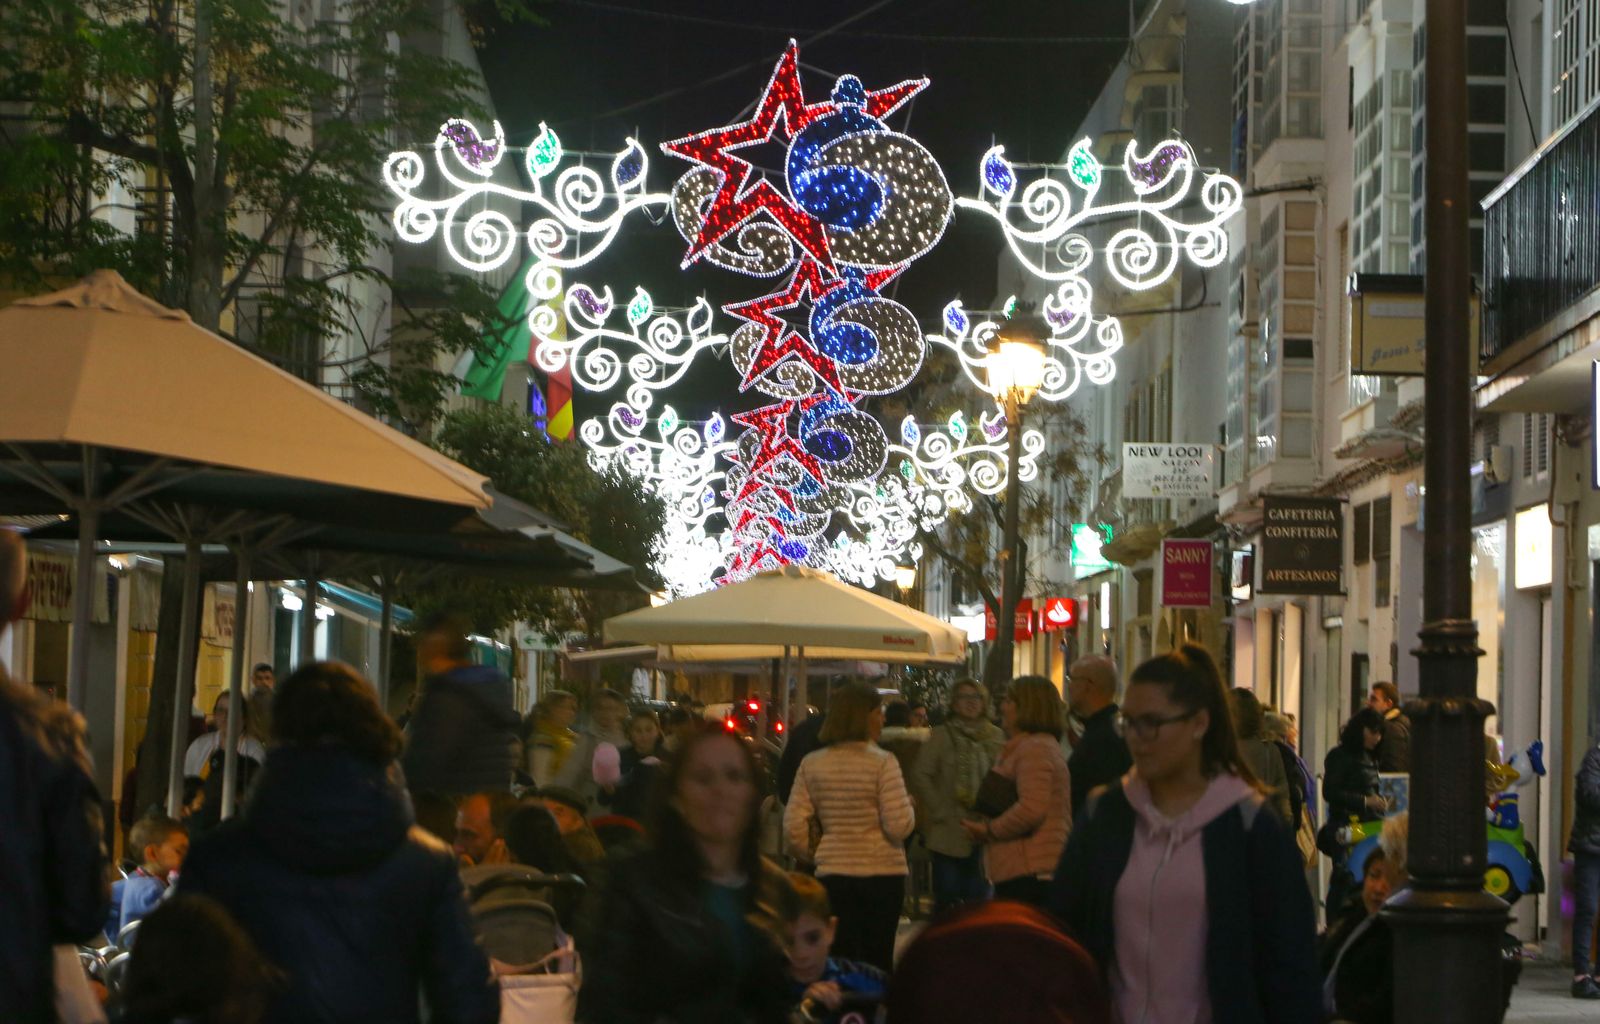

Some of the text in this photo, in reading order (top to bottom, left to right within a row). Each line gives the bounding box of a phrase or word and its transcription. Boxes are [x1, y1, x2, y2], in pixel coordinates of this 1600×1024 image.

[1128, 445, 1162, 457] NEW
[1166, 546, 1208, 565] SANNY
[1267, 569, 1337, 582] ARTESANOS
